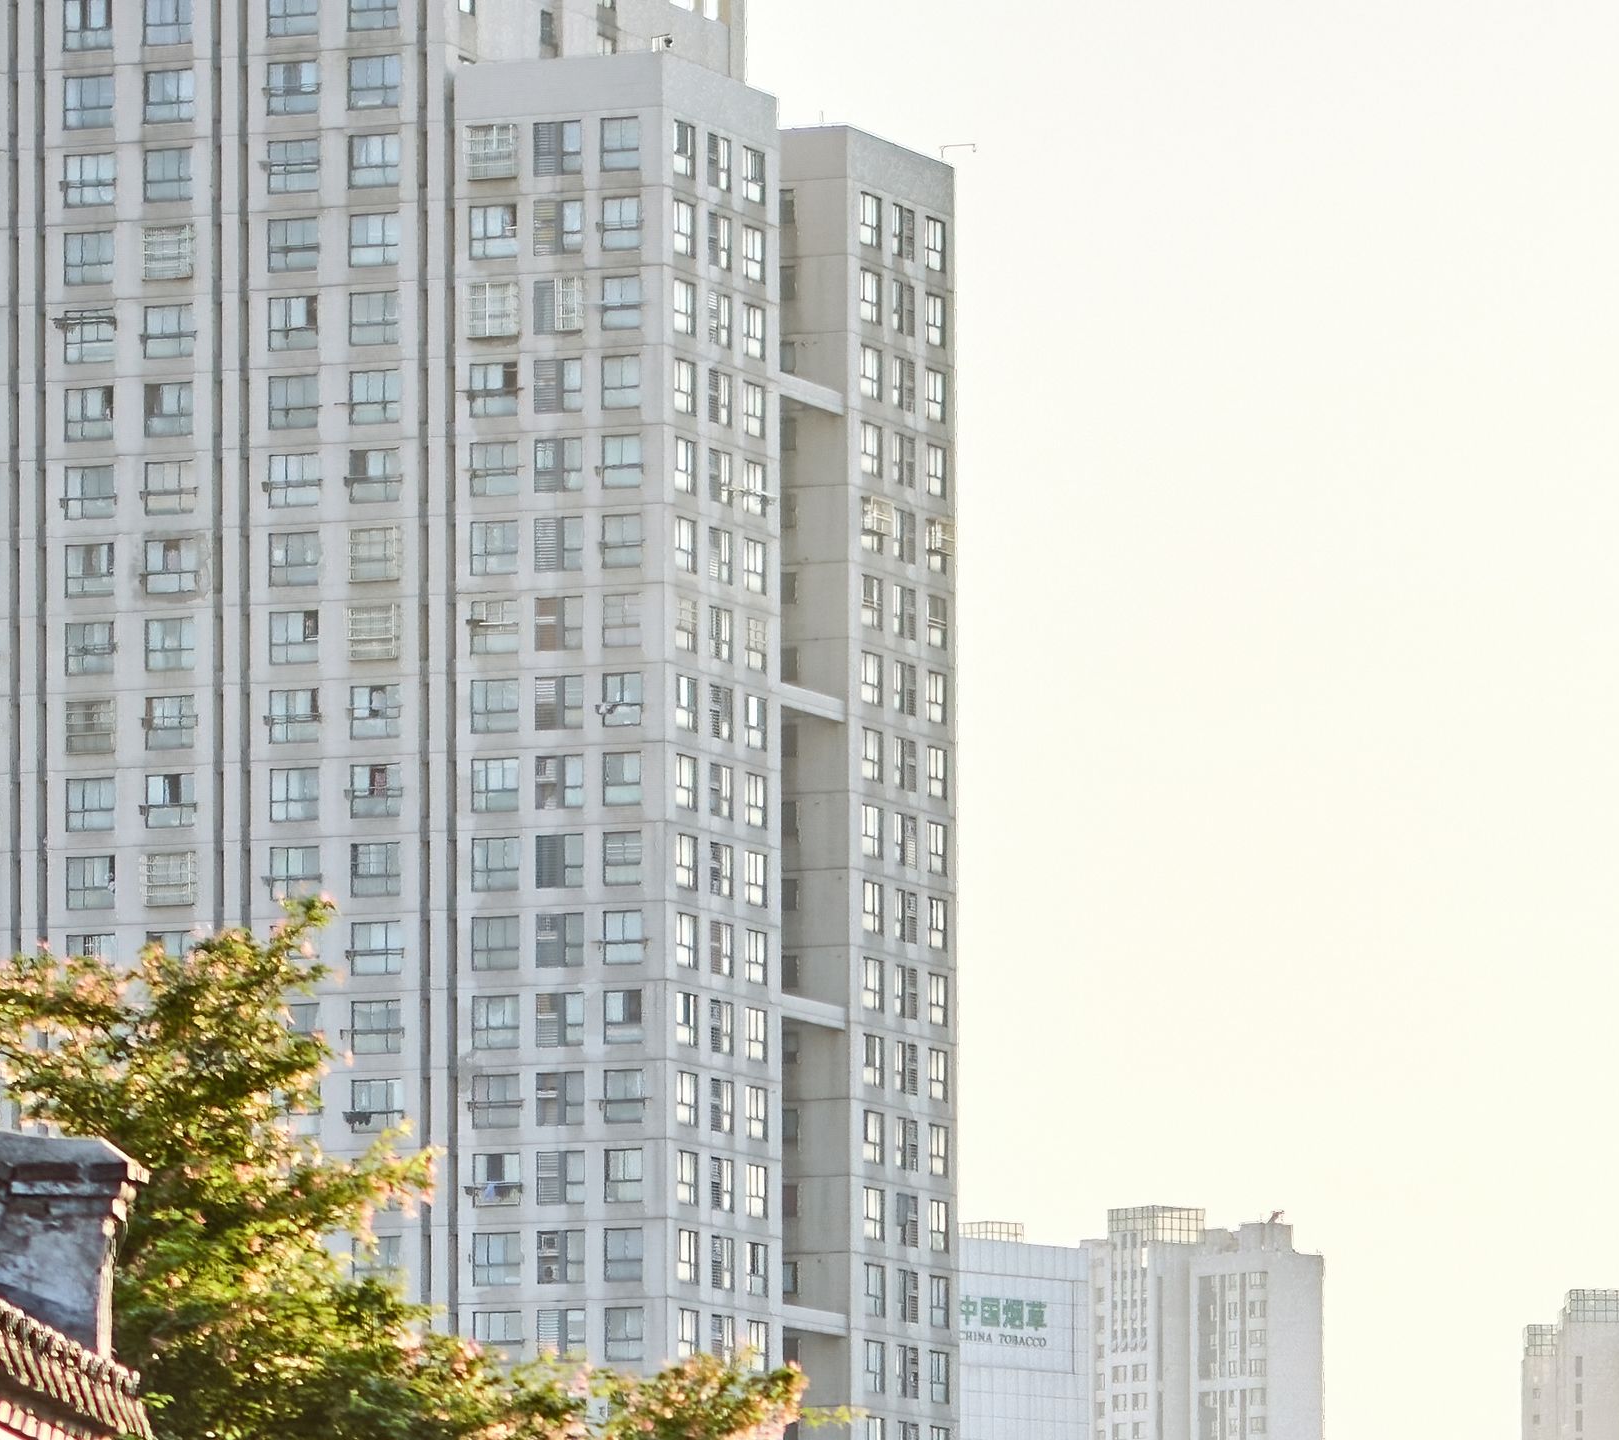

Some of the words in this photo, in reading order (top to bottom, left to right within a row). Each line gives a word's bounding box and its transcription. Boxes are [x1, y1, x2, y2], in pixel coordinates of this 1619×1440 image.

[959, 1295, 1047, 1331] 中国烟草
[999, 1333, 1047, 1348] TOBACCO
